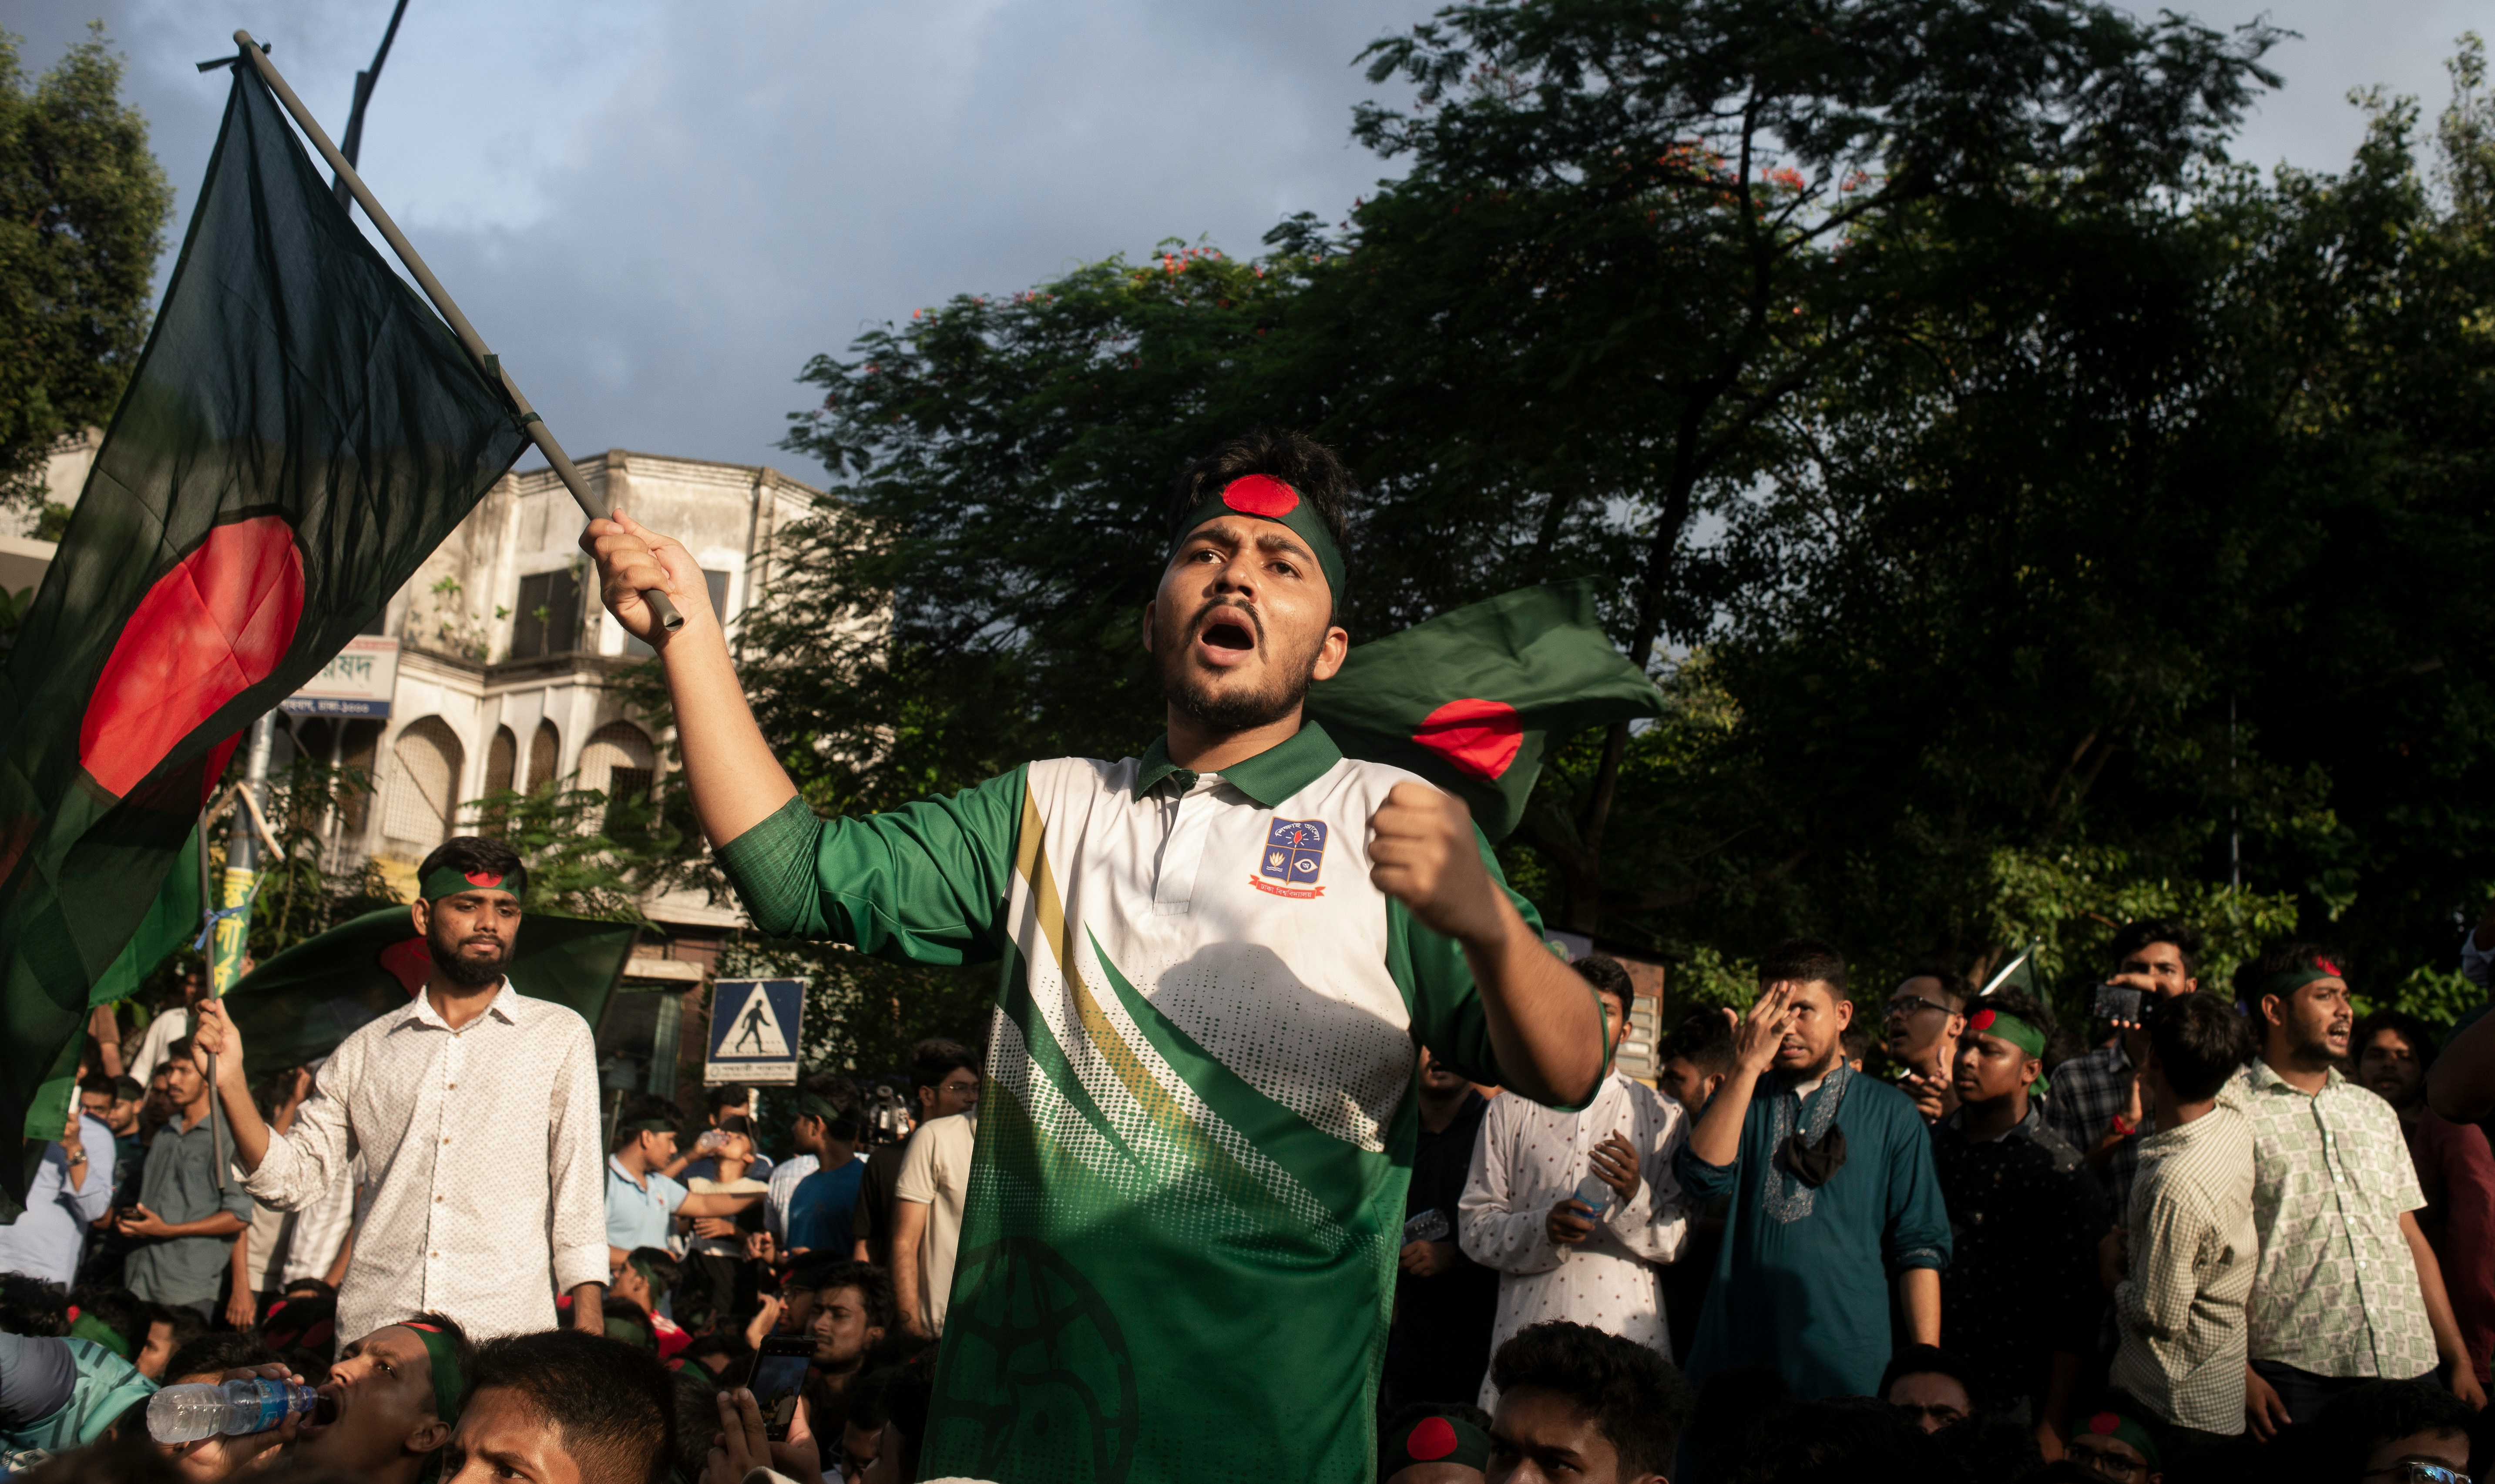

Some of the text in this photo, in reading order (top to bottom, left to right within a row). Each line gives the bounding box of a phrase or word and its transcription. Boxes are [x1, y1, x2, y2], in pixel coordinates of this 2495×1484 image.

[318, 700, 369, 713] ঢাকা-১০০০
[1275, 823, 1320, 841] শিক্ষাই আলো
[1260, 883, 1312, 898] ঢাকা বিশ্ববিদ্যালয়
